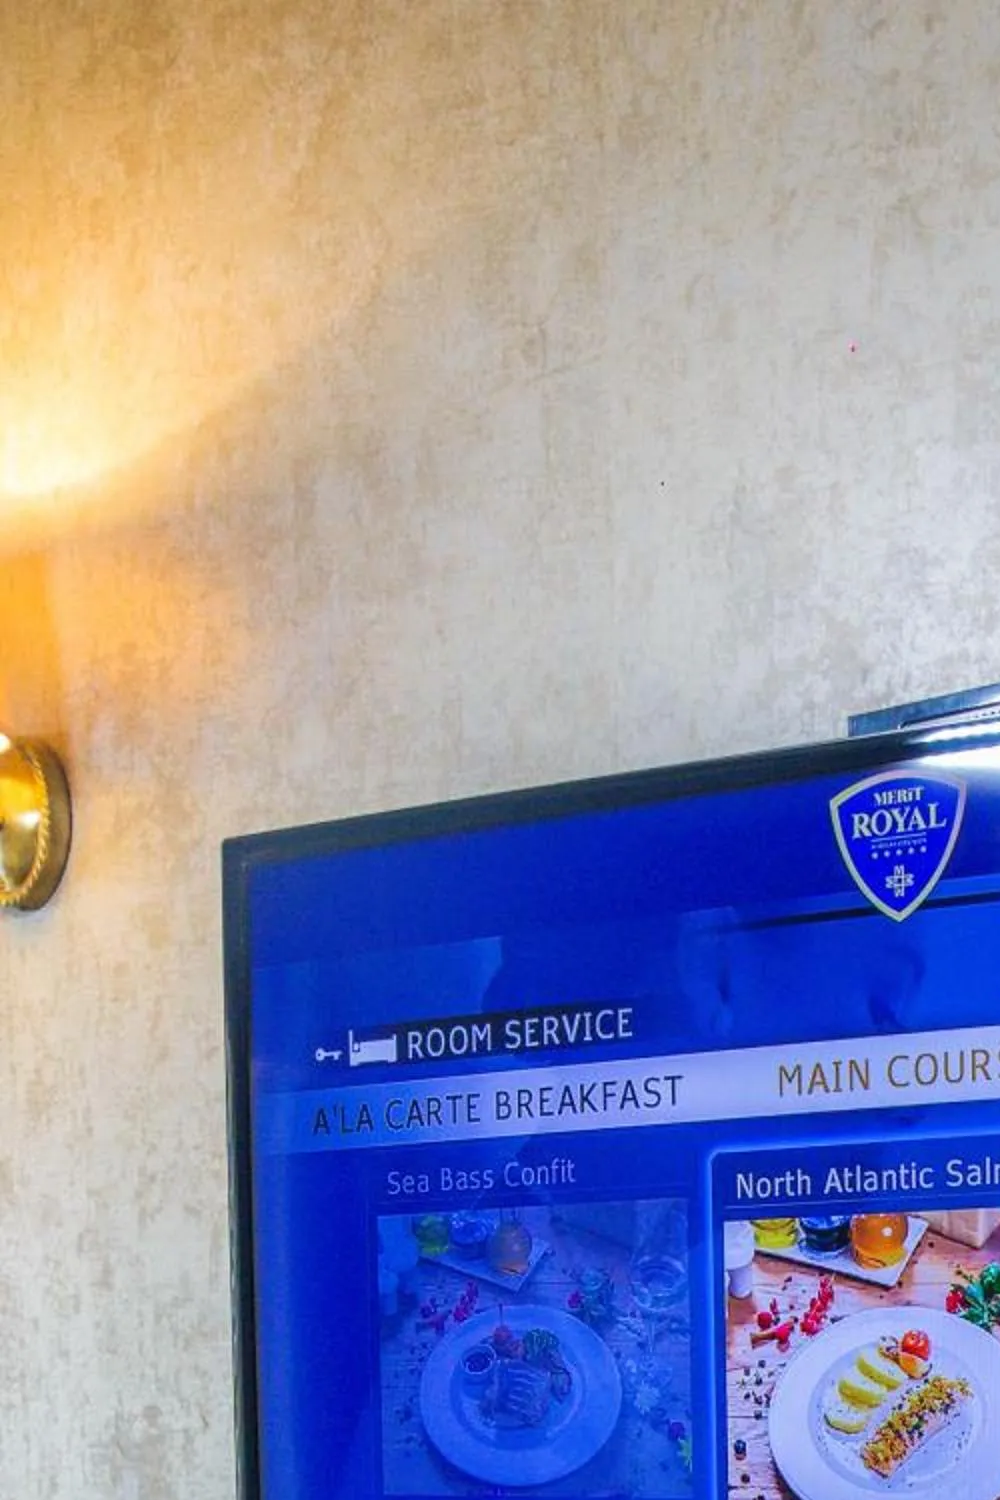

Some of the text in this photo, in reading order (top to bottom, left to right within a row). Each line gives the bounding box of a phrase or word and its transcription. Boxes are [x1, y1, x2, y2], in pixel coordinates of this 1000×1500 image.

[852, 802, 947, 839] ROYAL
[407, 1007, 634, 1060] ROOM SERVICE
[778, 1058, 871, 1097] MAIN
[312, 1075, 684, 1136] A'LA CARTE BREAKFAST
[387, 1158, 576, 1196] Sea Bass Confit
[736, 1169, 811, 1199] North
[824, 1160, 934, 1195] Atlantic
